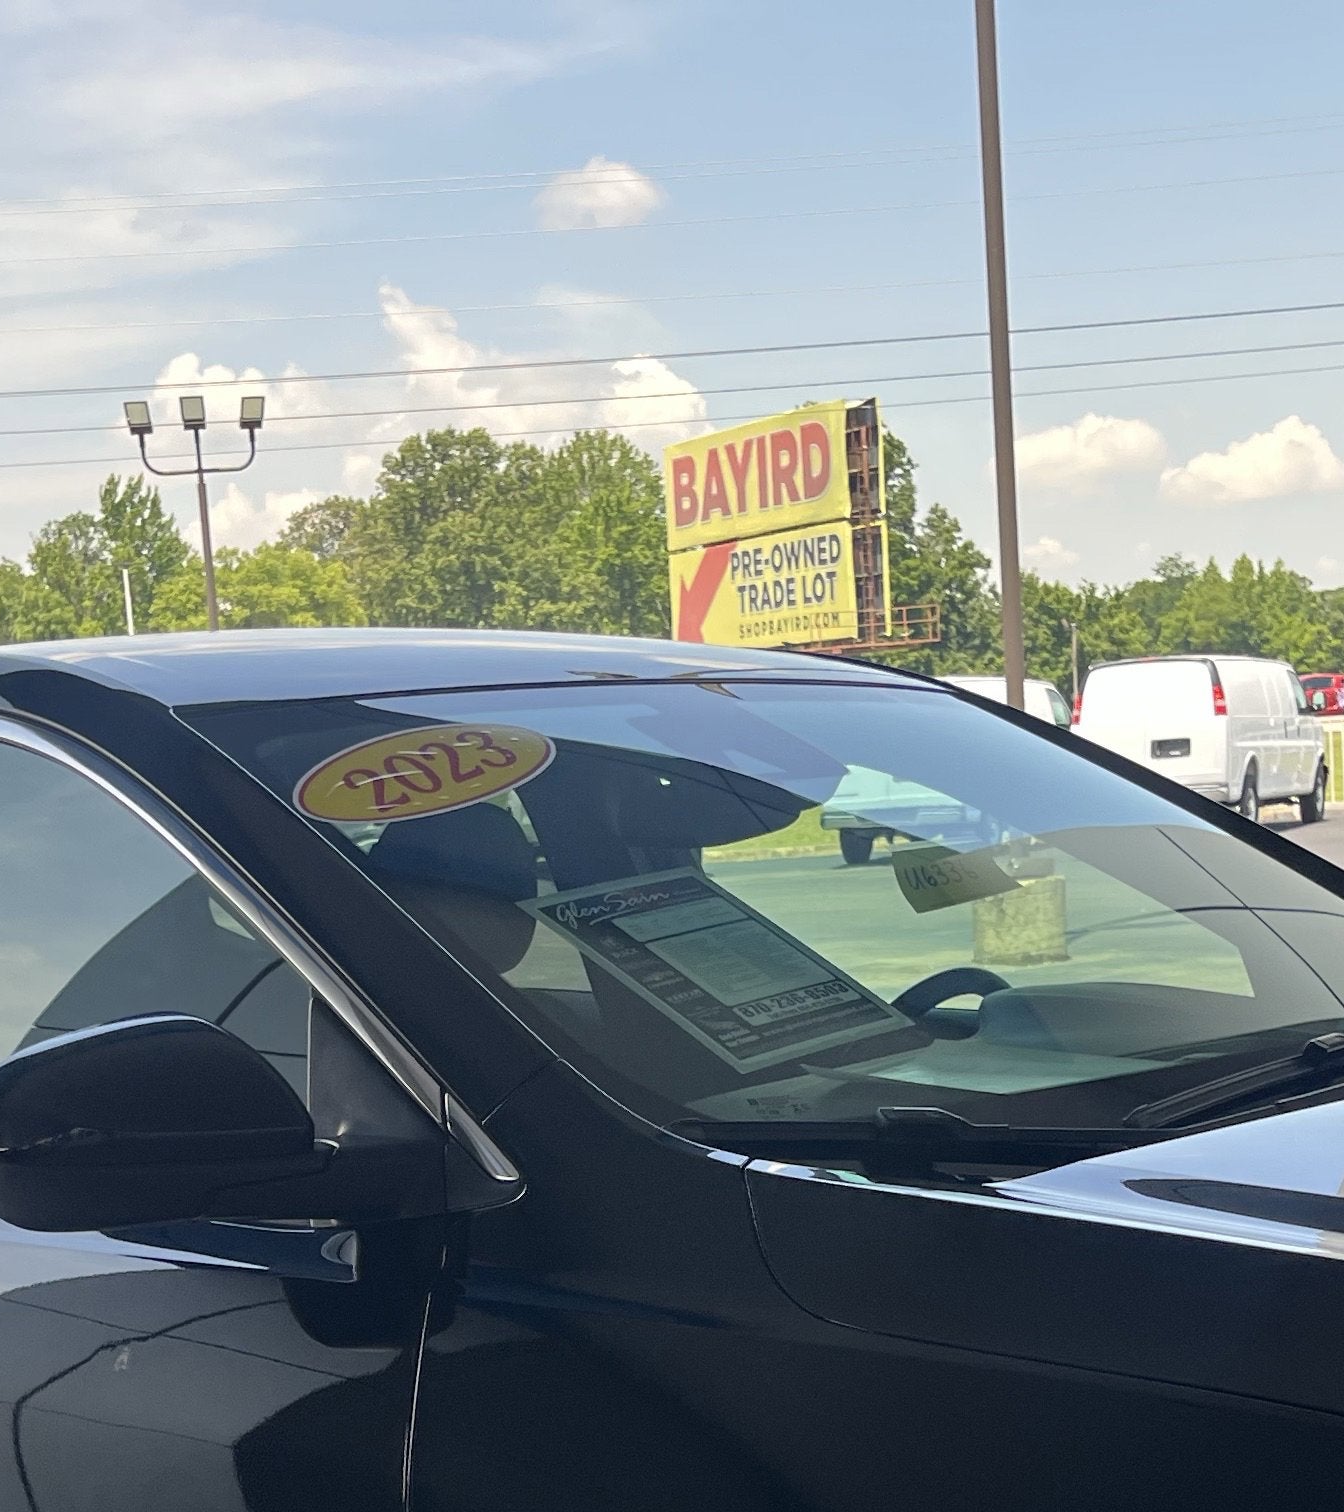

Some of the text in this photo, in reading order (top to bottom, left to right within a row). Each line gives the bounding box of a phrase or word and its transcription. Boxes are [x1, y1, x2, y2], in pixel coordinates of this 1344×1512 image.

[672, 421, 831, 528] BAYIRD
[731, 534, 841, 580] PRE-OWNED
[737, 571, 838, 613] TRADE LOT
[739, 612, 840, 639] SHOPBAYIRD.COM
[343, 732, 517, 813] 2023
